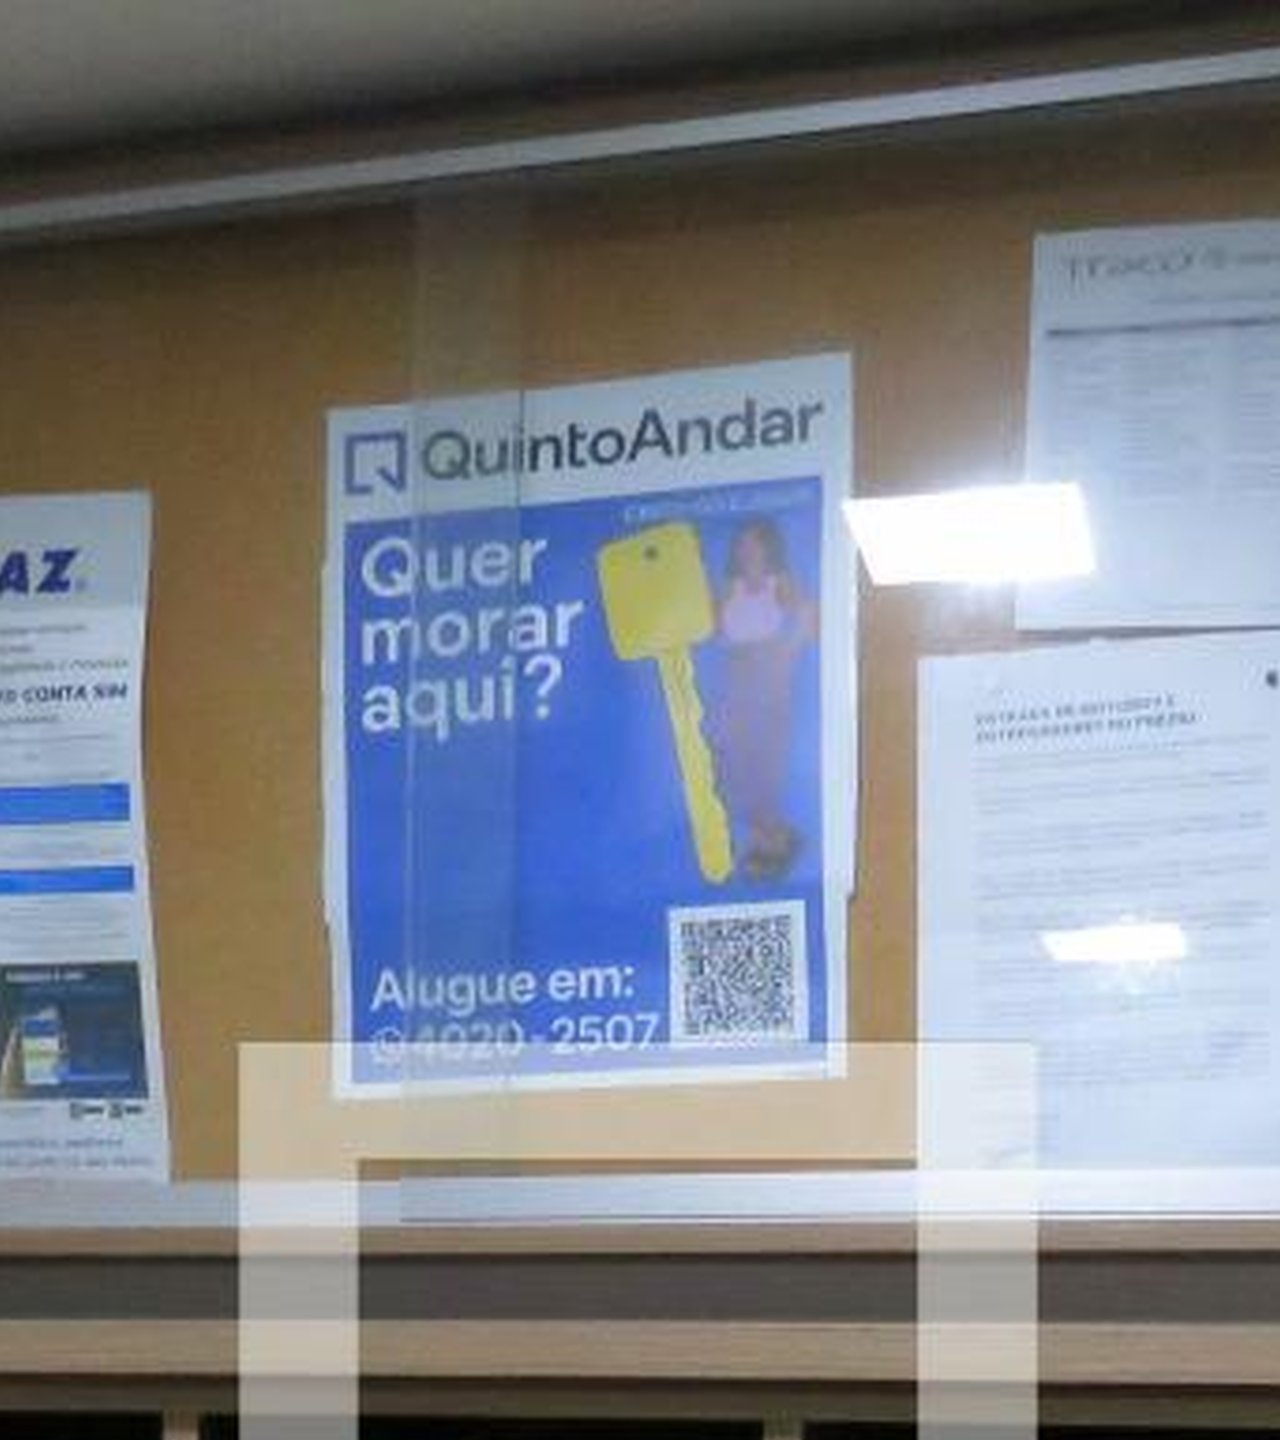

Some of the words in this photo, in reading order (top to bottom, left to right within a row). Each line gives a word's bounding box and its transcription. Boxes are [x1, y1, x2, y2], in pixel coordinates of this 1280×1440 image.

[422, 398, 823, 481] QuintoAndar
[361, 536, 548, 598] Quer
[361, 601, 584, 665] morar
[361, 656, 563, 740] aqui?
[370, 962, 538, 1014] Alugue
[548, 964, 634, 1000] em:
